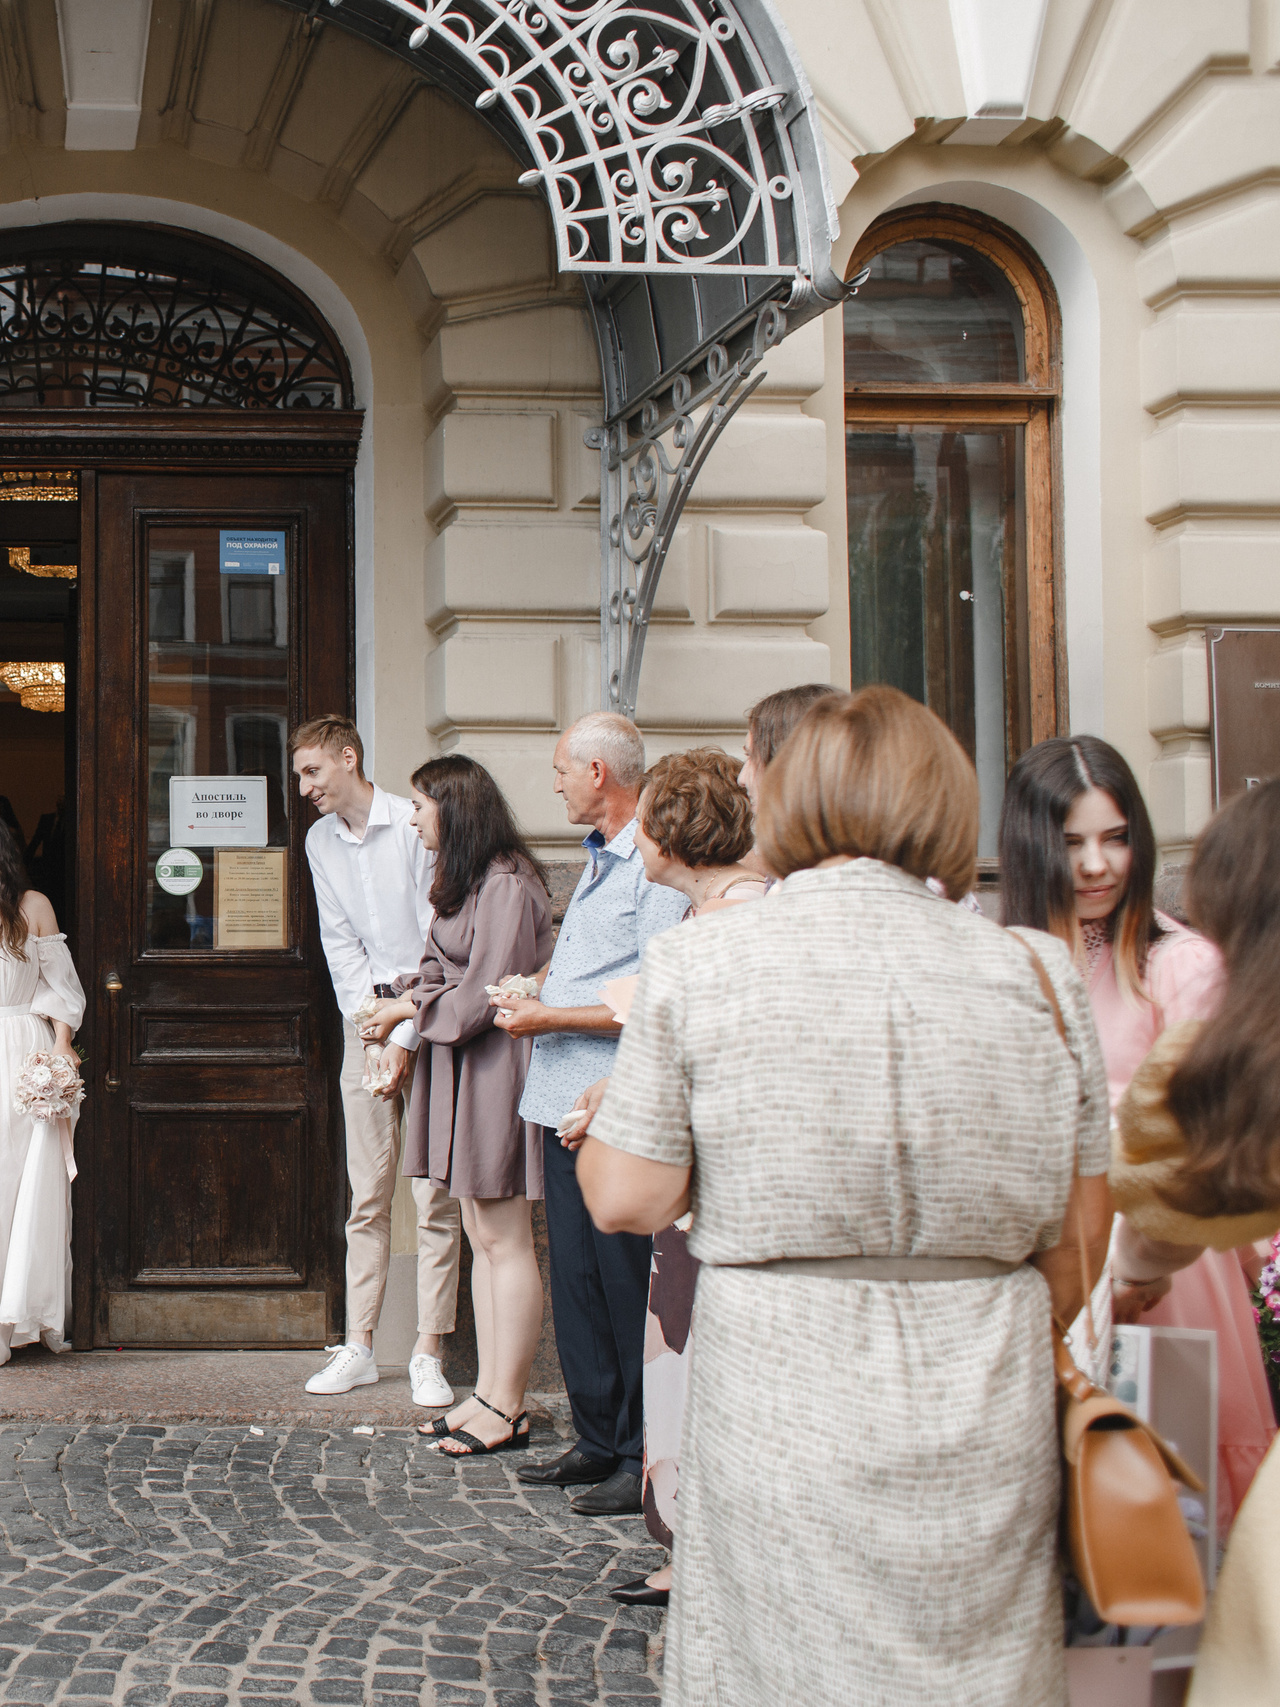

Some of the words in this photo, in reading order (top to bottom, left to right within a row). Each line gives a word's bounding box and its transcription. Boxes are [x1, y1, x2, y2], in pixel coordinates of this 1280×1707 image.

[243, 541, 278, 549] ОХРАНОЙ
[191, 792, 247, 802] Апостиль
[195, 811, 209, 819] во
[211, 810, 244, 821] дворе
